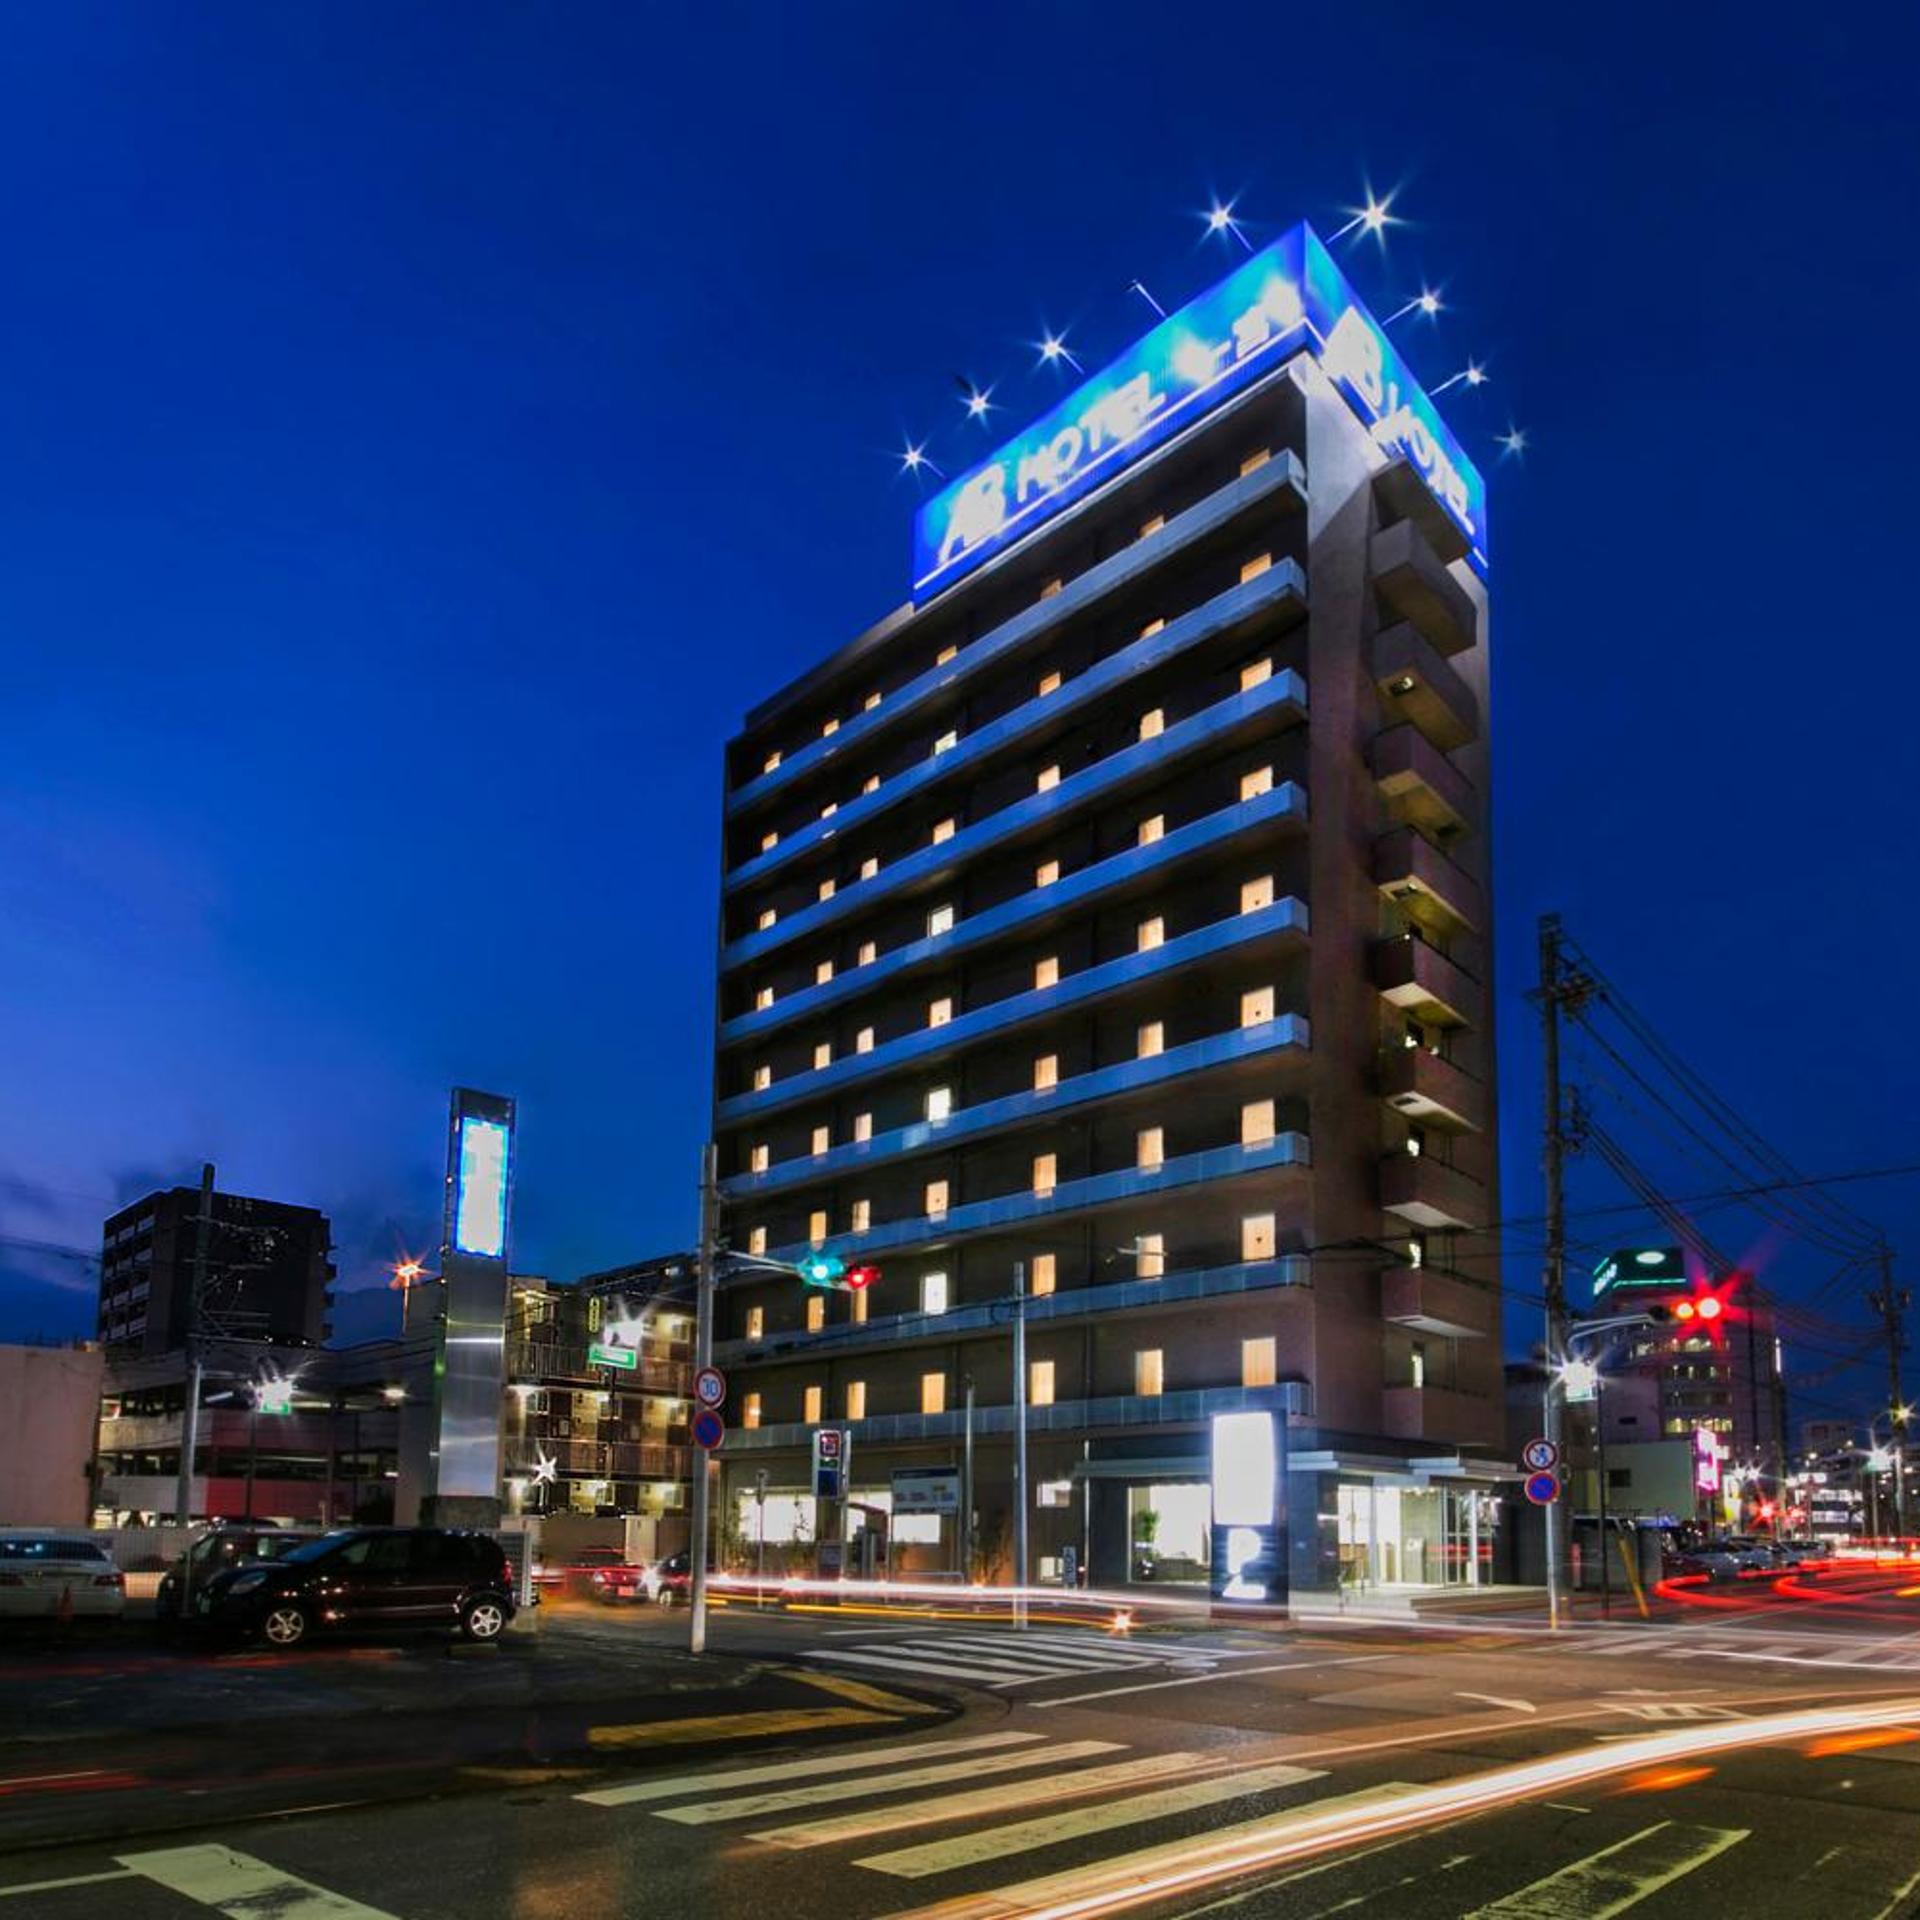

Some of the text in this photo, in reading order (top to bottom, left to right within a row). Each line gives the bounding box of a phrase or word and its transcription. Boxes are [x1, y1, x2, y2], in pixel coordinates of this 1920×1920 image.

[1016, 371, 1167, 504] HOTEL
[1372, 381, 1476, 537] HOTEL
[702, 1378, 719, 1397] 30
[1227, 1528, 1262, 1575] P
